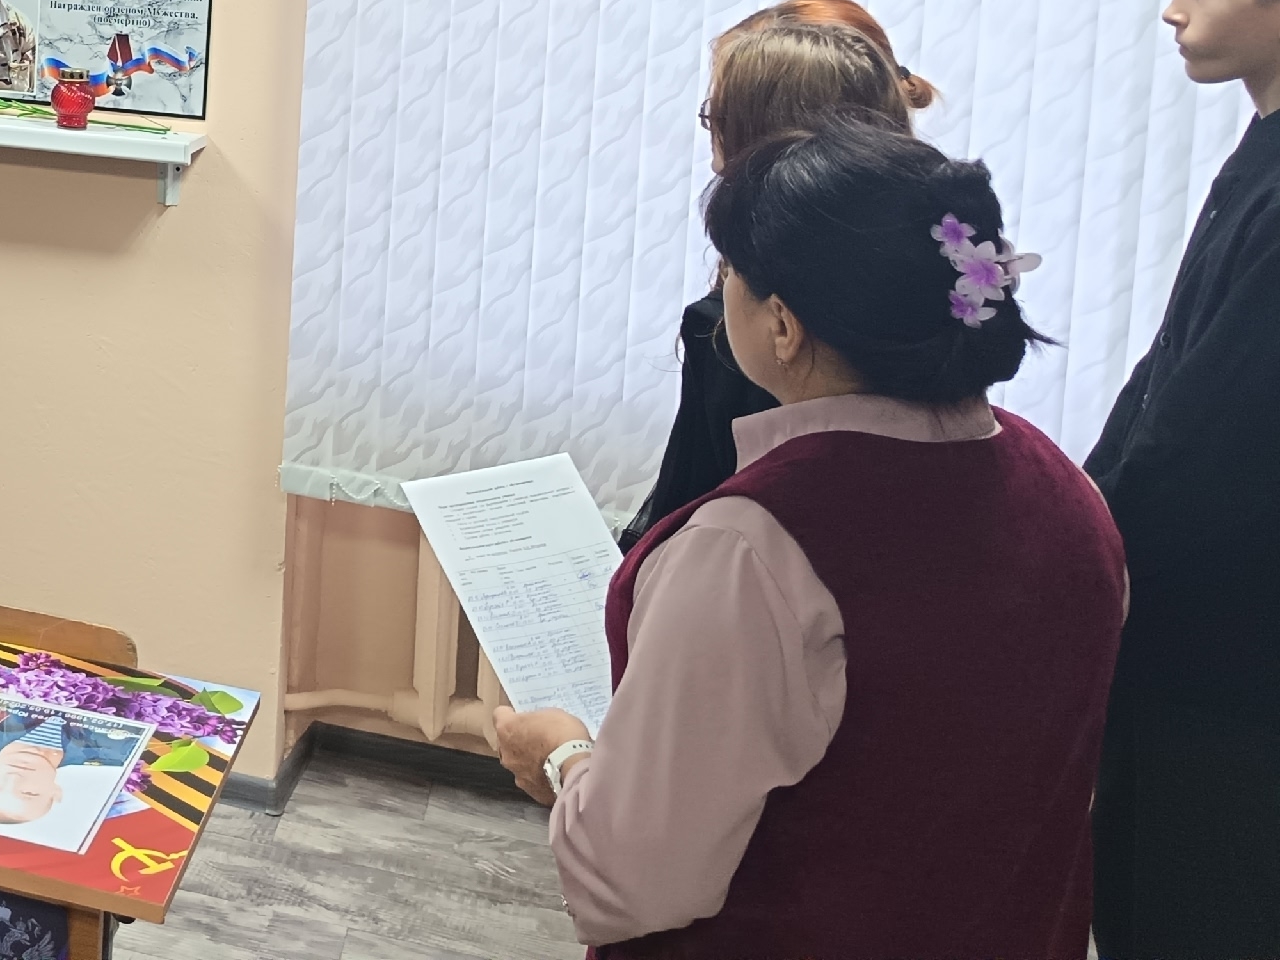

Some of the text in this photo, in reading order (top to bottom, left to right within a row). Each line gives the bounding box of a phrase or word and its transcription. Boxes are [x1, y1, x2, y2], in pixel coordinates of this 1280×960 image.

[50, 0, 101, 13] Награжден
[103, 5, 143, 17] орденом
[93, 15, 151, 28] (посмертно)
